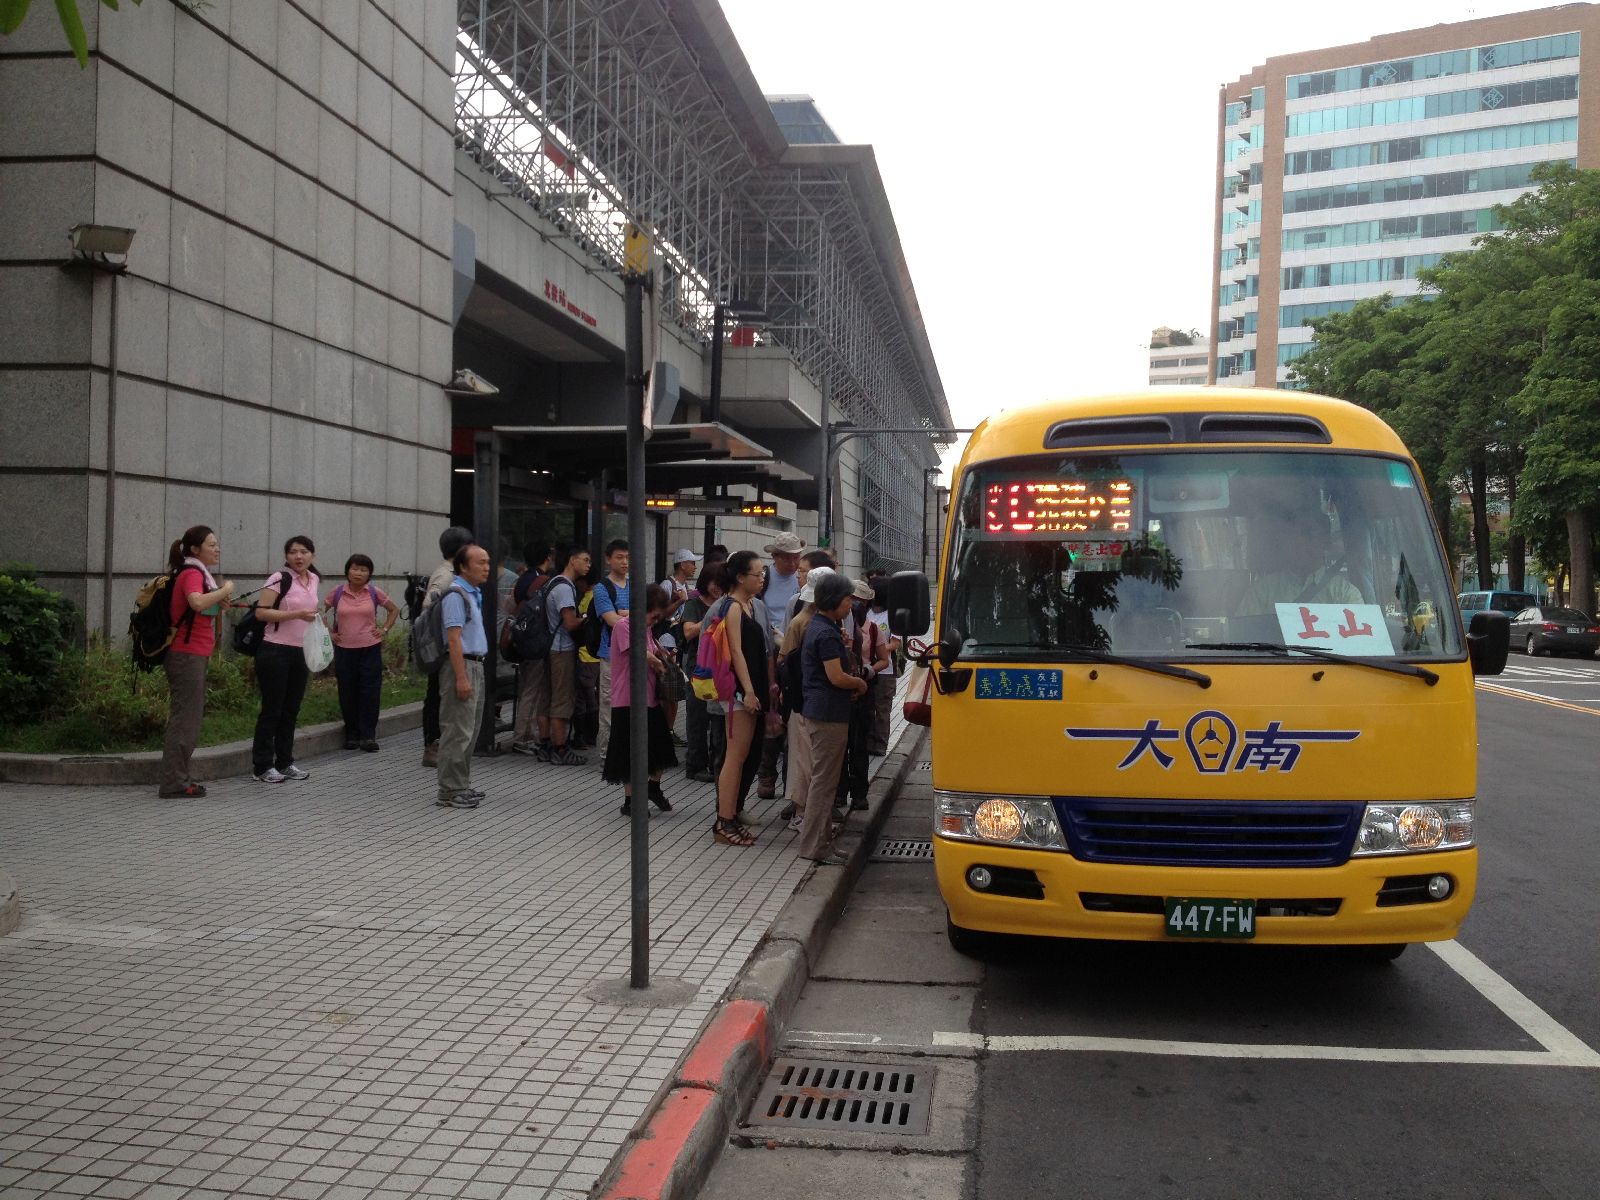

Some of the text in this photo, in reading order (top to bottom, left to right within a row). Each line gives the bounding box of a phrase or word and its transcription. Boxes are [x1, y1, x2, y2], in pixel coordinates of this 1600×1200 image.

[1297, 606, 1374, 639] 上山
[1065, 719, 1361, 772] 大南
[1169, 905, 1253, 932] 447-FW
